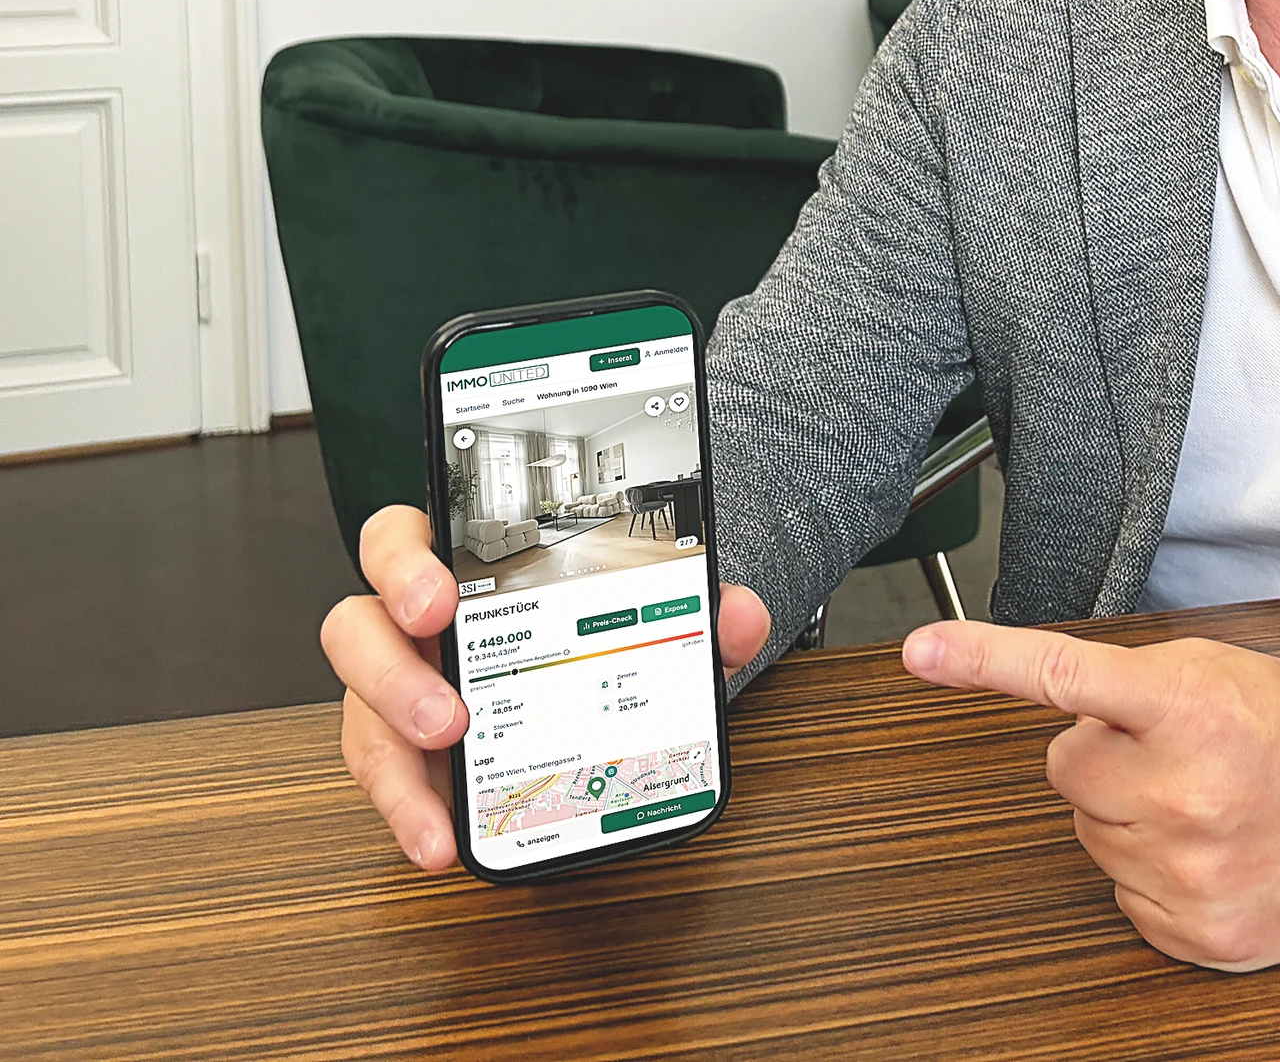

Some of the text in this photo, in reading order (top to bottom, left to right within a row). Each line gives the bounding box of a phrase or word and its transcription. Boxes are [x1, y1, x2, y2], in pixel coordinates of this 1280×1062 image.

[654, 345, 689, 357] Anmelden
[607, 354, 633, 365] Inserat
[446, 366, 546, 393] IMMO UNITED
[455, 381, 618, 415] Startseite Suche Wohnung in 1090 Wien
[464, 600, 540, 624] PRUNKSTÜCK
[664, 603, 688, 614] Exposé
[592, 615, 633, 628] Preis-Check
[467, 629, 532, 651] € 449.000
[617, 671, 638, 680] Zimmer
[493, 720, 524, 731] Stockwerk
[494, 731, 504, 739] EG
[474, 756, 495, 767] Lage
[487, 753, 582, 781] 1090 Wien, Tendlergasse 3
[643, 773, 690, 792] Alsergrund
[646, 803, 682, 817] Nachricht
[527, 833, 561, 846] anzeigen
